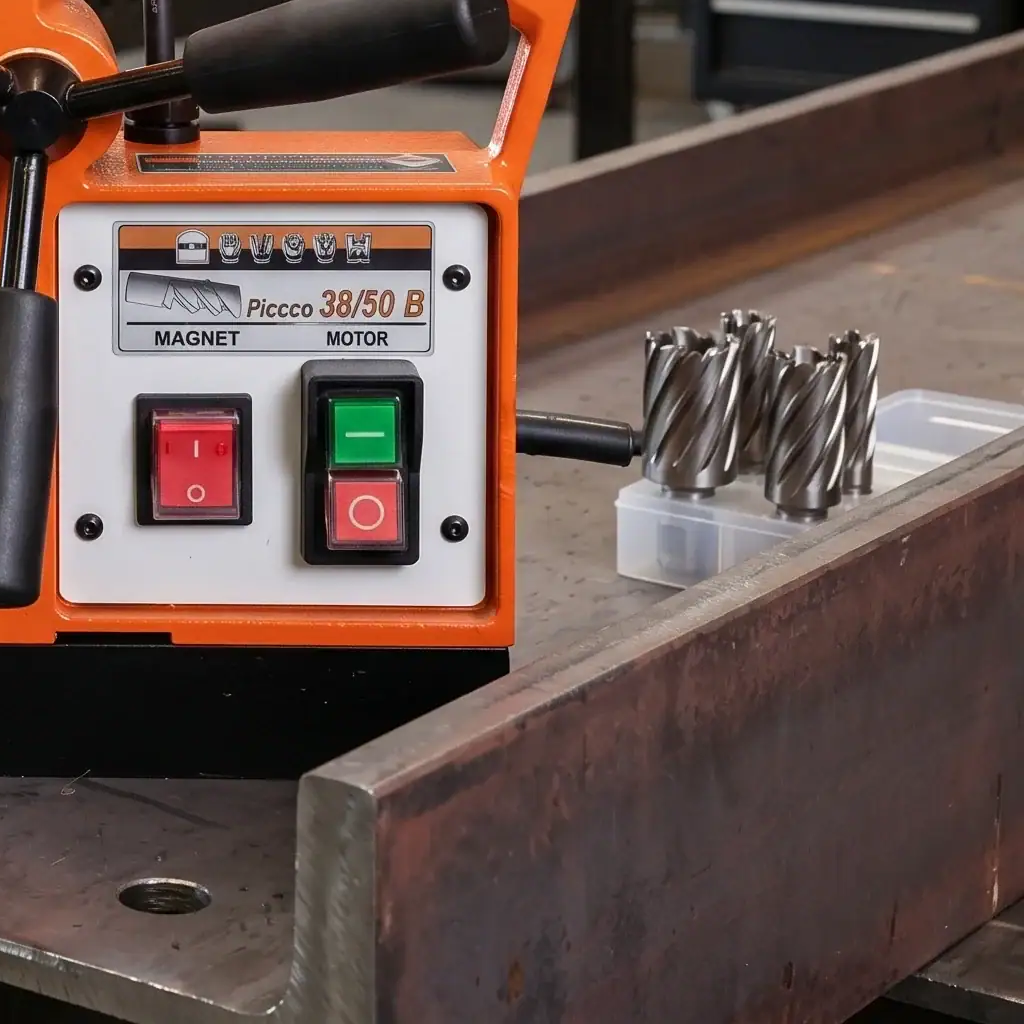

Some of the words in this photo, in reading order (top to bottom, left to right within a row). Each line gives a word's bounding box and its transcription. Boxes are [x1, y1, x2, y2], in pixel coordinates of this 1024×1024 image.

[319, 289, 396, 319] 38/50
[403, 289, 425, 318] B
[154, 330, 240, 346] MAGNET
[326, 330, 389, 347] MOTOR
